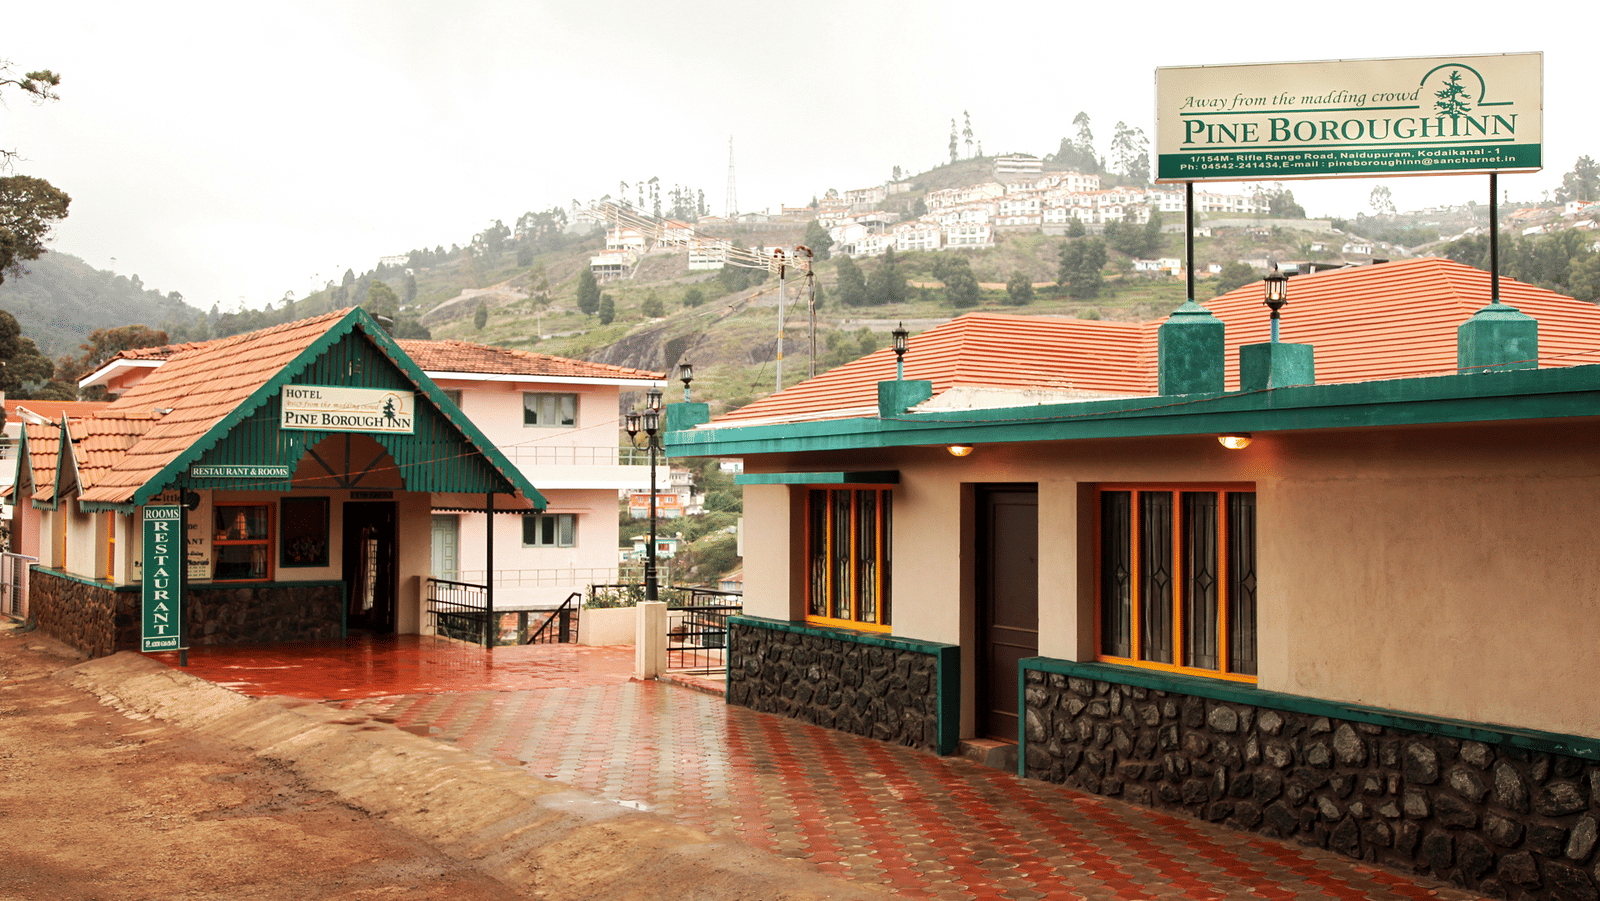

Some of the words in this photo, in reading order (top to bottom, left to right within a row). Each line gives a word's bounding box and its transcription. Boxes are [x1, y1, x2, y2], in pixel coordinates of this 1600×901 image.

[1180, 96, 1228, 111] Away
[1227, 93, 1267, 111] from
[1272, 91, 1296, 105] the
[1300, 89, 1367, 107] madding
[1371, 87, 1423, 103] crowd
[1182, 119, 1260, 144] PINE
[1180, 163, 1199, 171] Ph:
[1328, 155, 1516, 169] pineboroughinn@sancharnet.in
[1190, 155, 1234, 163] 1/154M-
[1236, 154, 1263, 162] Rifle
[1265, 154, 1301, 163] Range
[1304, 153, 1338, 161] Road,
[1340, 151, 1415, 161] Naidupuram,
[1417, 148, 1485, 157] Kodaikanal
[286, 389, 322, 399] HOTEL
[285, 411, 318, 425] PINE
[250, 467, 257, 476] &
[257, 467, 288, 476] ROOMS
[145, 509, 179, 519] ROOMS
[153, 521, 170, 635] RESTAURANT
